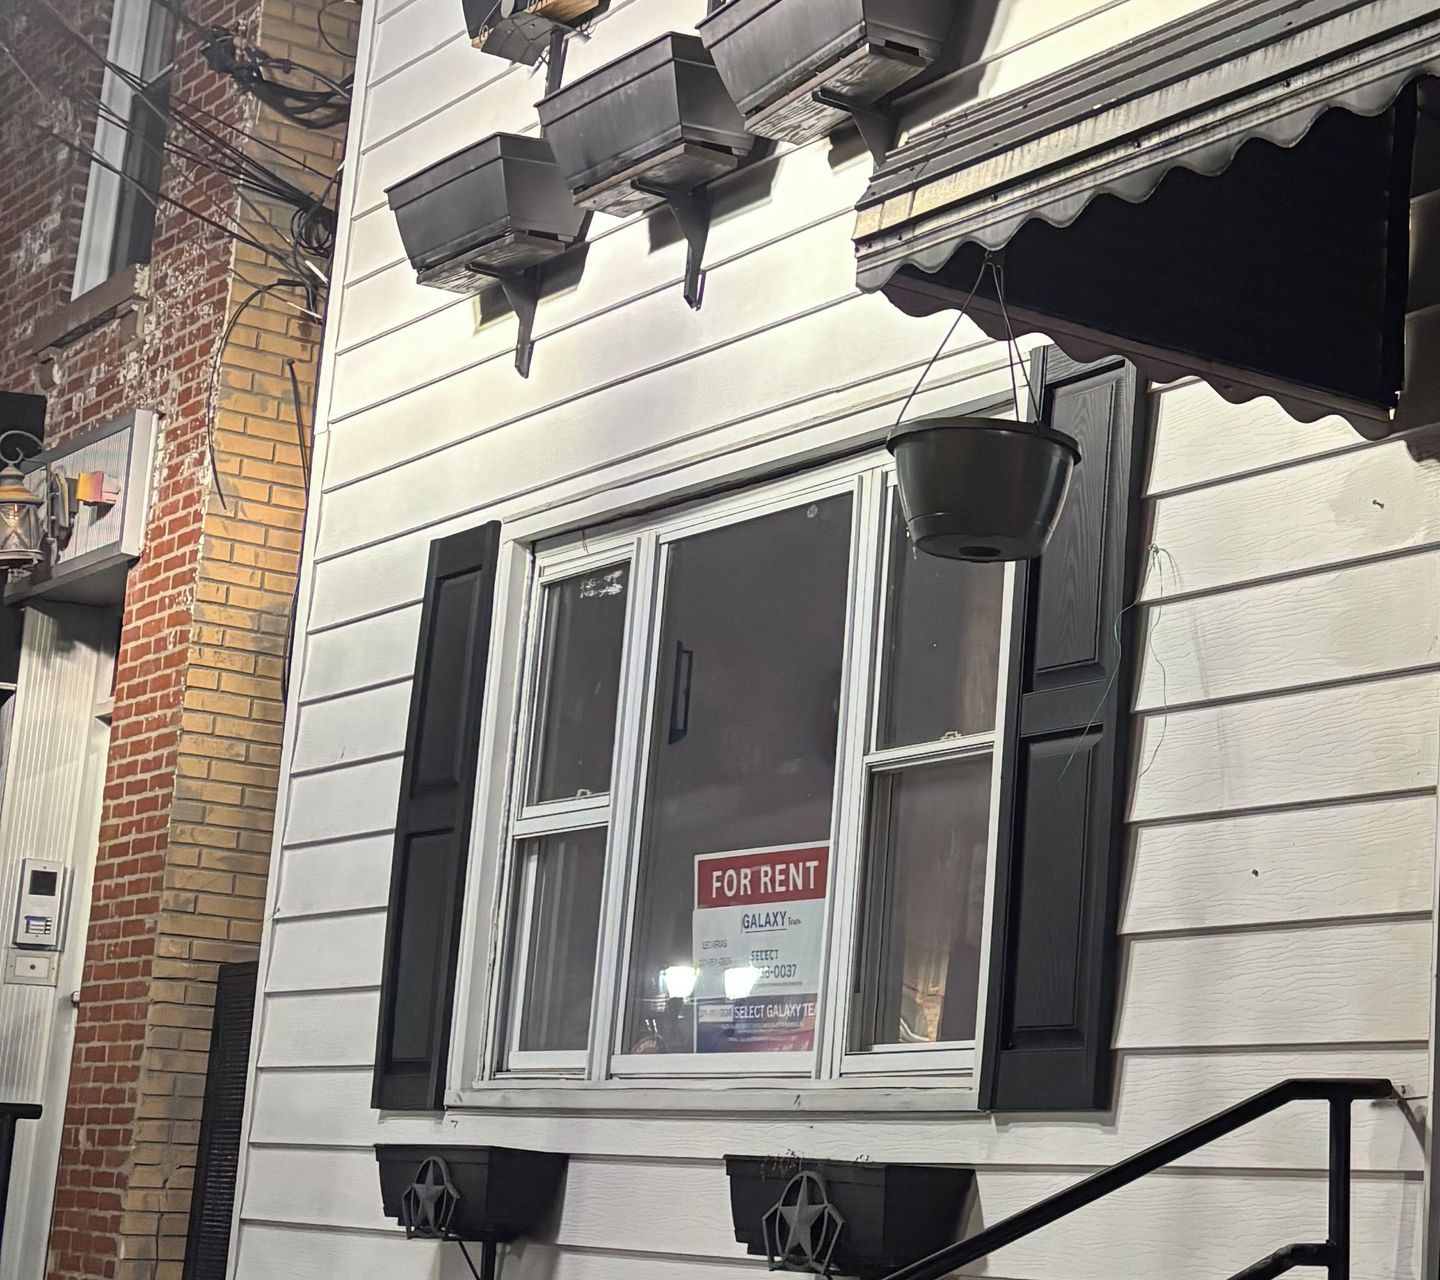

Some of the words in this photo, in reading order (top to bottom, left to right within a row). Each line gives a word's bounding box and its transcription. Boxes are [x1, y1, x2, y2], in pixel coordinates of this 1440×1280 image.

[711, 868, 752, 898] FOR
[760, 860, 819, 894] RENT
[742, 910, 787, 929] GALAXY
[751, 949, 779, 961] SELECT
[734, 1004, 765, 1019] SELECT
[766, 1002, 801, 1018] GALAXY
